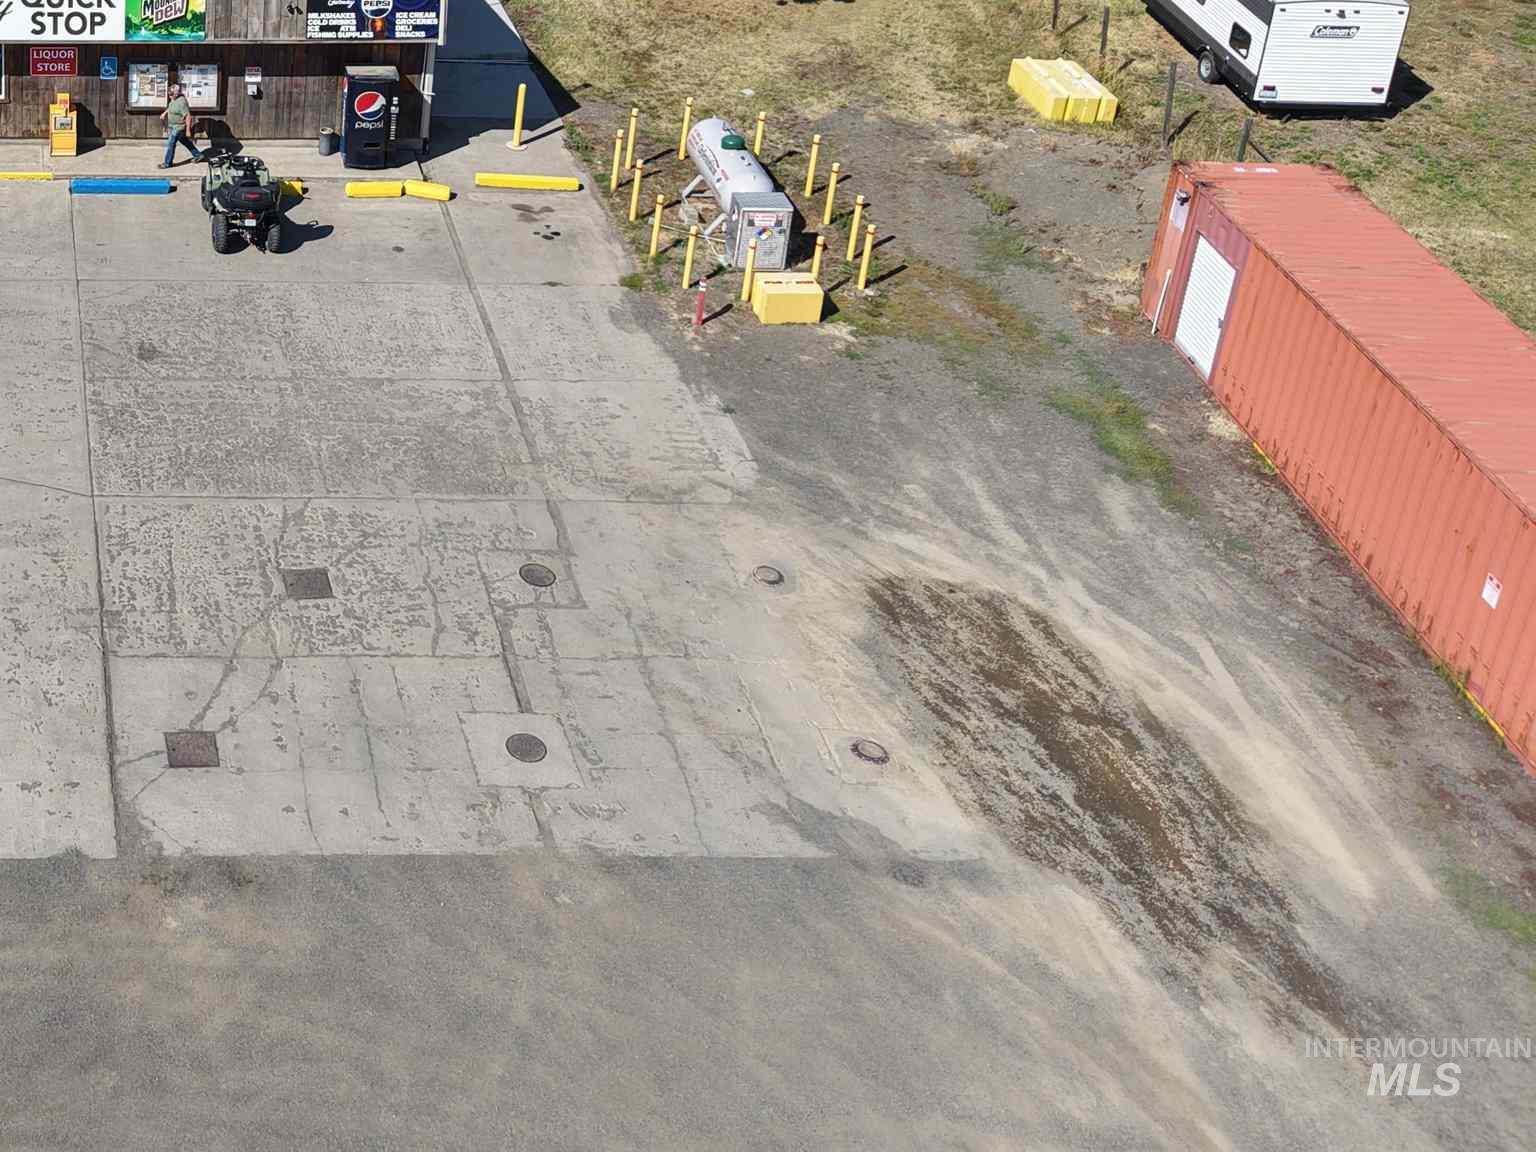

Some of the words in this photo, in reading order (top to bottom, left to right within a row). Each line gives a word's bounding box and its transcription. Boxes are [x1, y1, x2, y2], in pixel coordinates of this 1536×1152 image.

[30, 11, 106, 36] STOP
[33, 49, 75, 59] LIQUOR
[37, 63, 71, 72] STORE
[355, 120, 384, 130] pepsi
